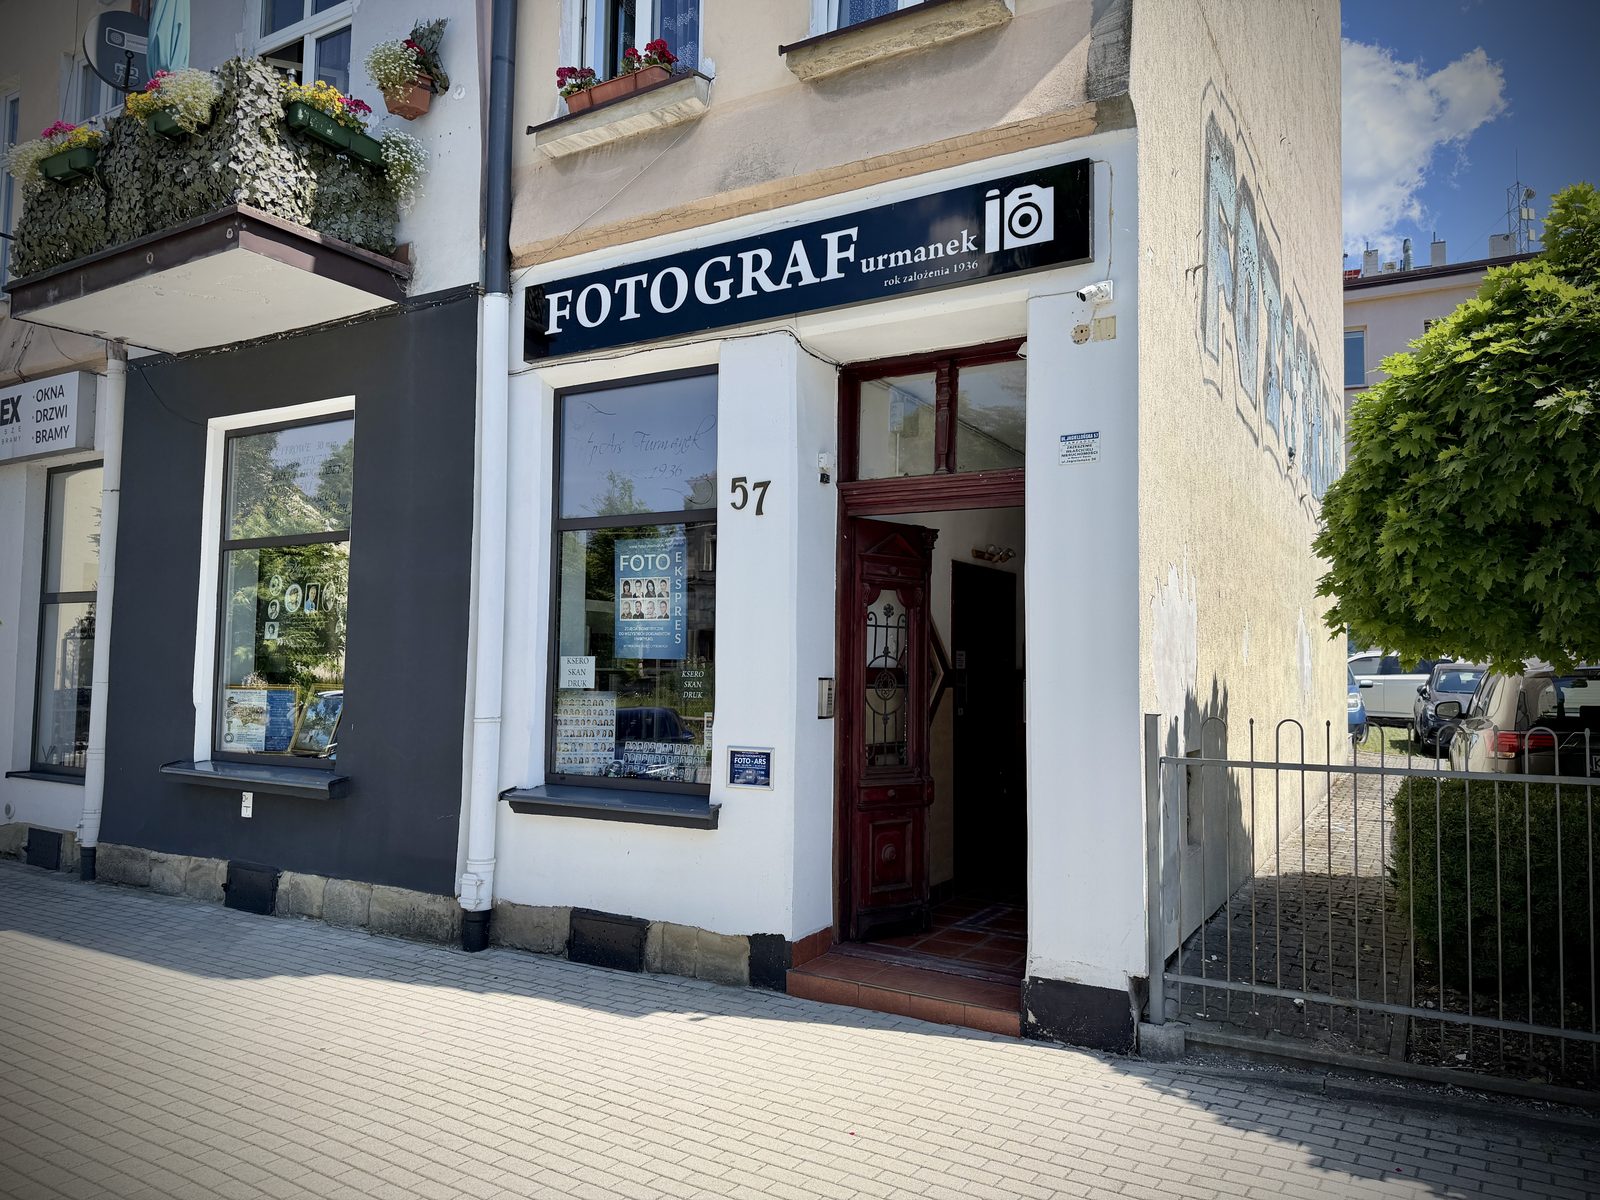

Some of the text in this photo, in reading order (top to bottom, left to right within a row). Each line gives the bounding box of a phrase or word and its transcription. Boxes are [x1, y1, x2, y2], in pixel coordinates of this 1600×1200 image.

[545, 227, 978, 335] FOTOGRAF urmanek
[884, 260, 979, 287] rok założenia 1936
[36, 385, 65, 402] OKNA
[35, 404, 68, 423] DRZWI
[35, 425, 70, 444] BRAMY
[730, 476, 771, 516] 57
[620, 553, 670, 571] FOTO
[674, 551, 682, 644] EKSPRES
